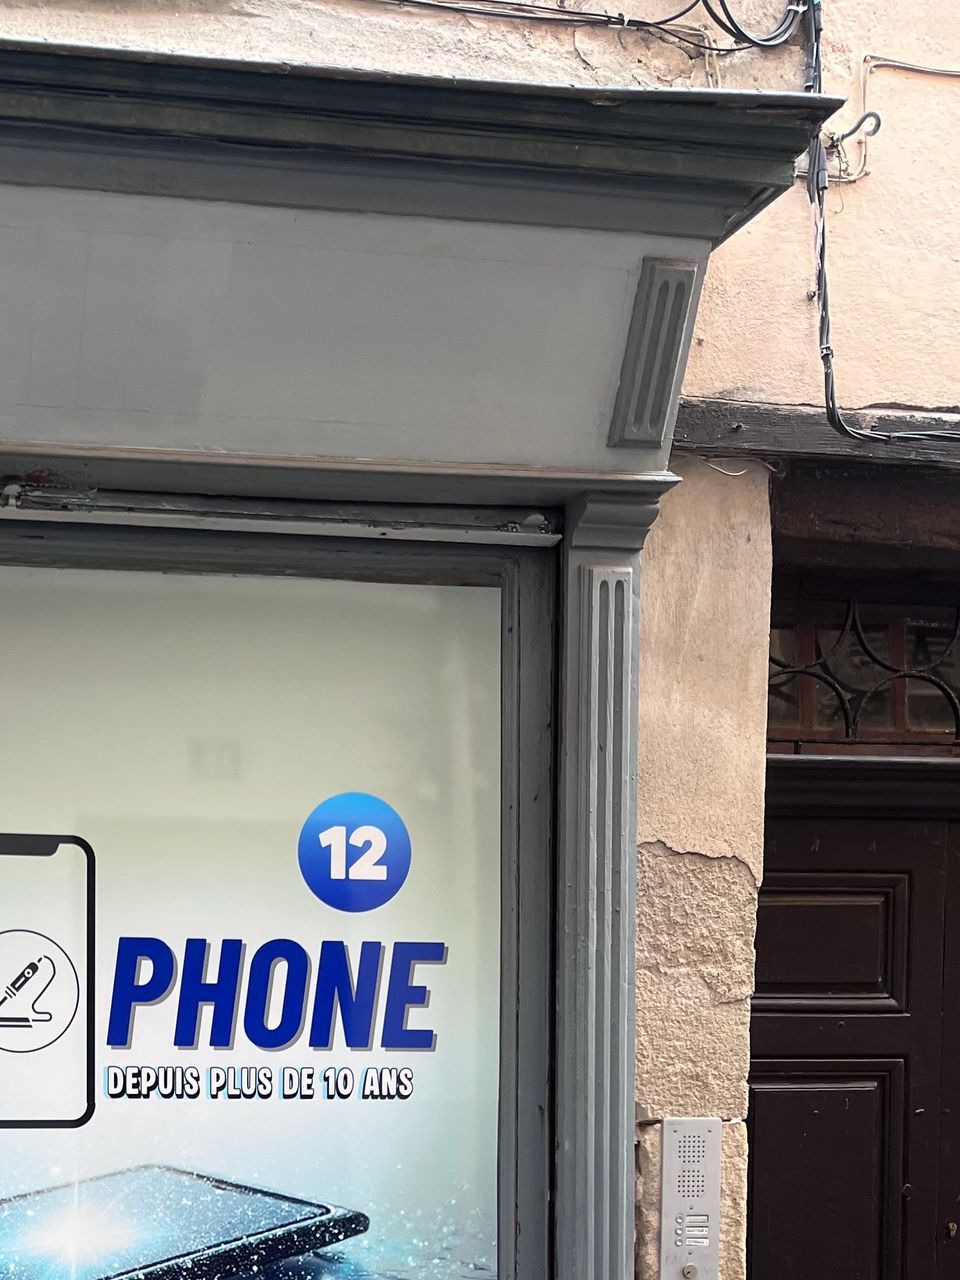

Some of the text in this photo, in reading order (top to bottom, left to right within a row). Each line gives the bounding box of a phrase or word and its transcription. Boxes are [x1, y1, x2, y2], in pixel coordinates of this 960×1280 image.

[318, 825, 387, 880] 12
[106, 936, 449, 1051] PHONE
[106, 1066, 414, 1100] DEPUIS PLUS DE 10 ANS
